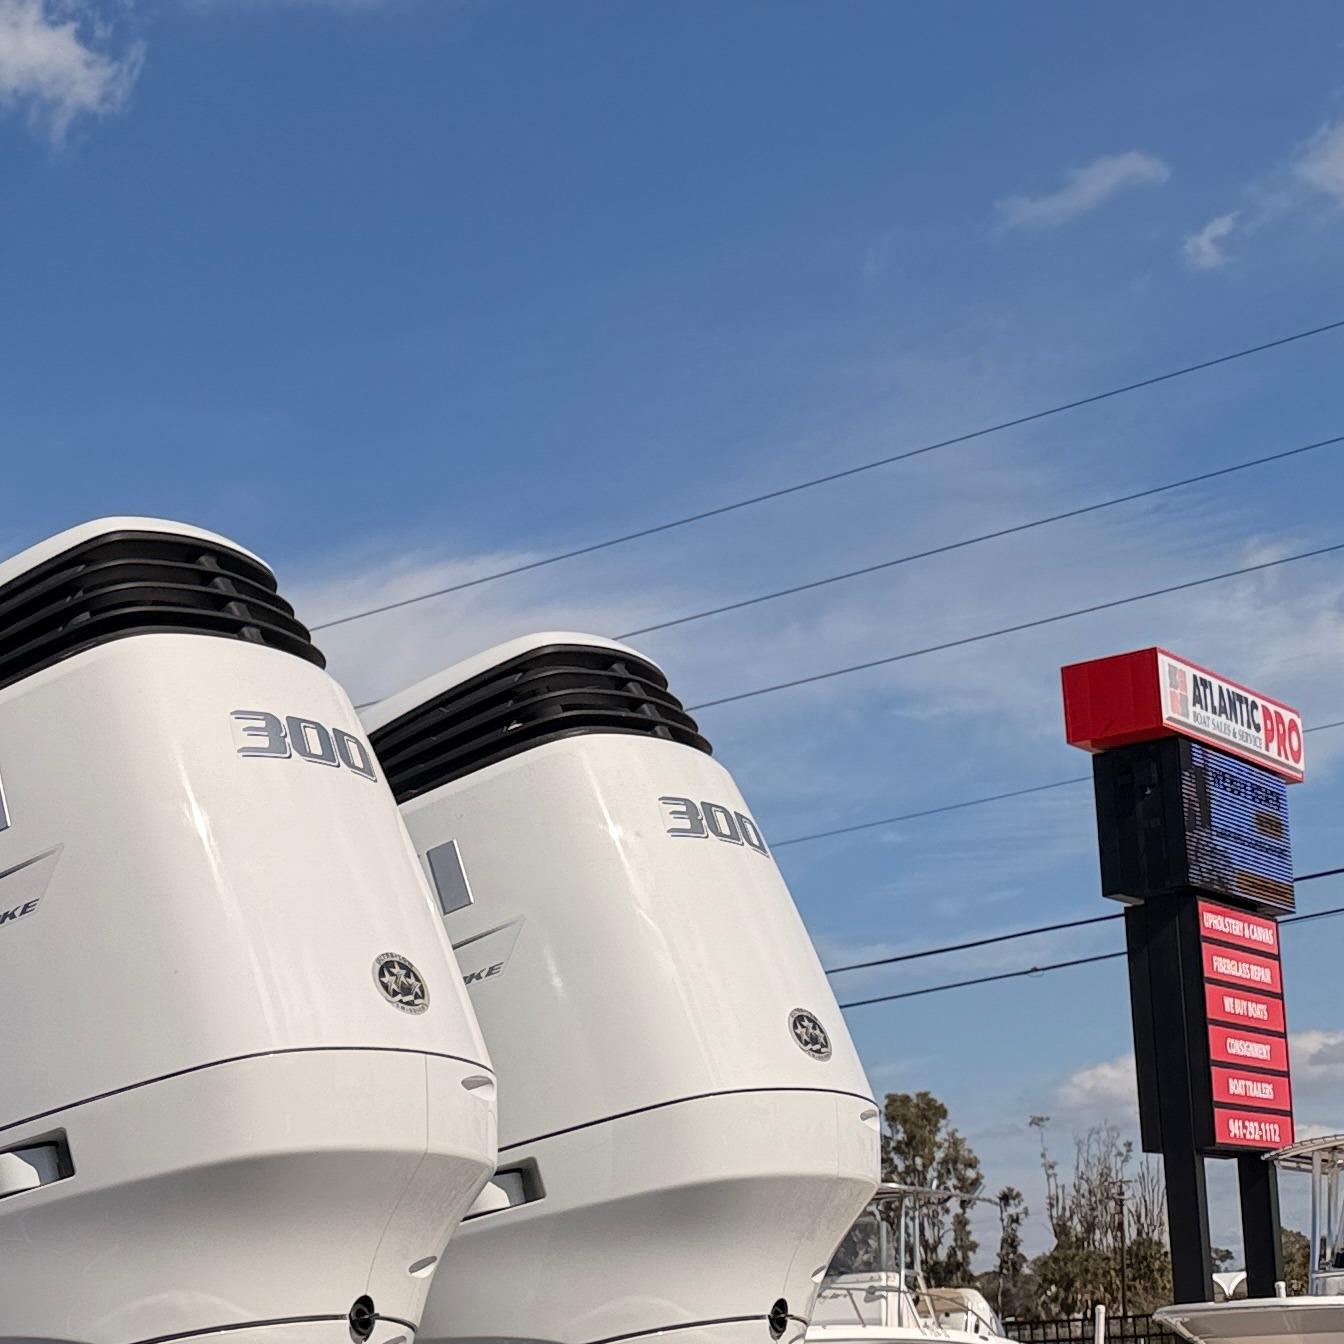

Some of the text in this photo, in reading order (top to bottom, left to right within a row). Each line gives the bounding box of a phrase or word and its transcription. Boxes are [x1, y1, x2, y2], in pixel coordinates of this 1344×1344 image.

[1192, 673, 1302, 765] ATLANTIC PRO
[1193, 710, 1211, 728] BOAT
[1212, 719, 1232, 737] SALES
[1238, 728, 1263, 749] SERVICE
[230, 710, 378, 783] 300
[658, 796, 770, 858] 300
[1203, 911, 1243, 937] UPHOLSTERY
[1249, 923, 1274, 945] CANVAS
[1212, 955, 1272, 984] FIBERGLASS REPAIR
[1223, 995, 1268, 1020] WE BUY BOATS
[1226, 1037, 1271, 1061] CONSIGNMENT
[1228, 1078, 1274, 1100] BOAT TRAILERS
[1228, 1118, 1281, 1143] 941-292-1112
